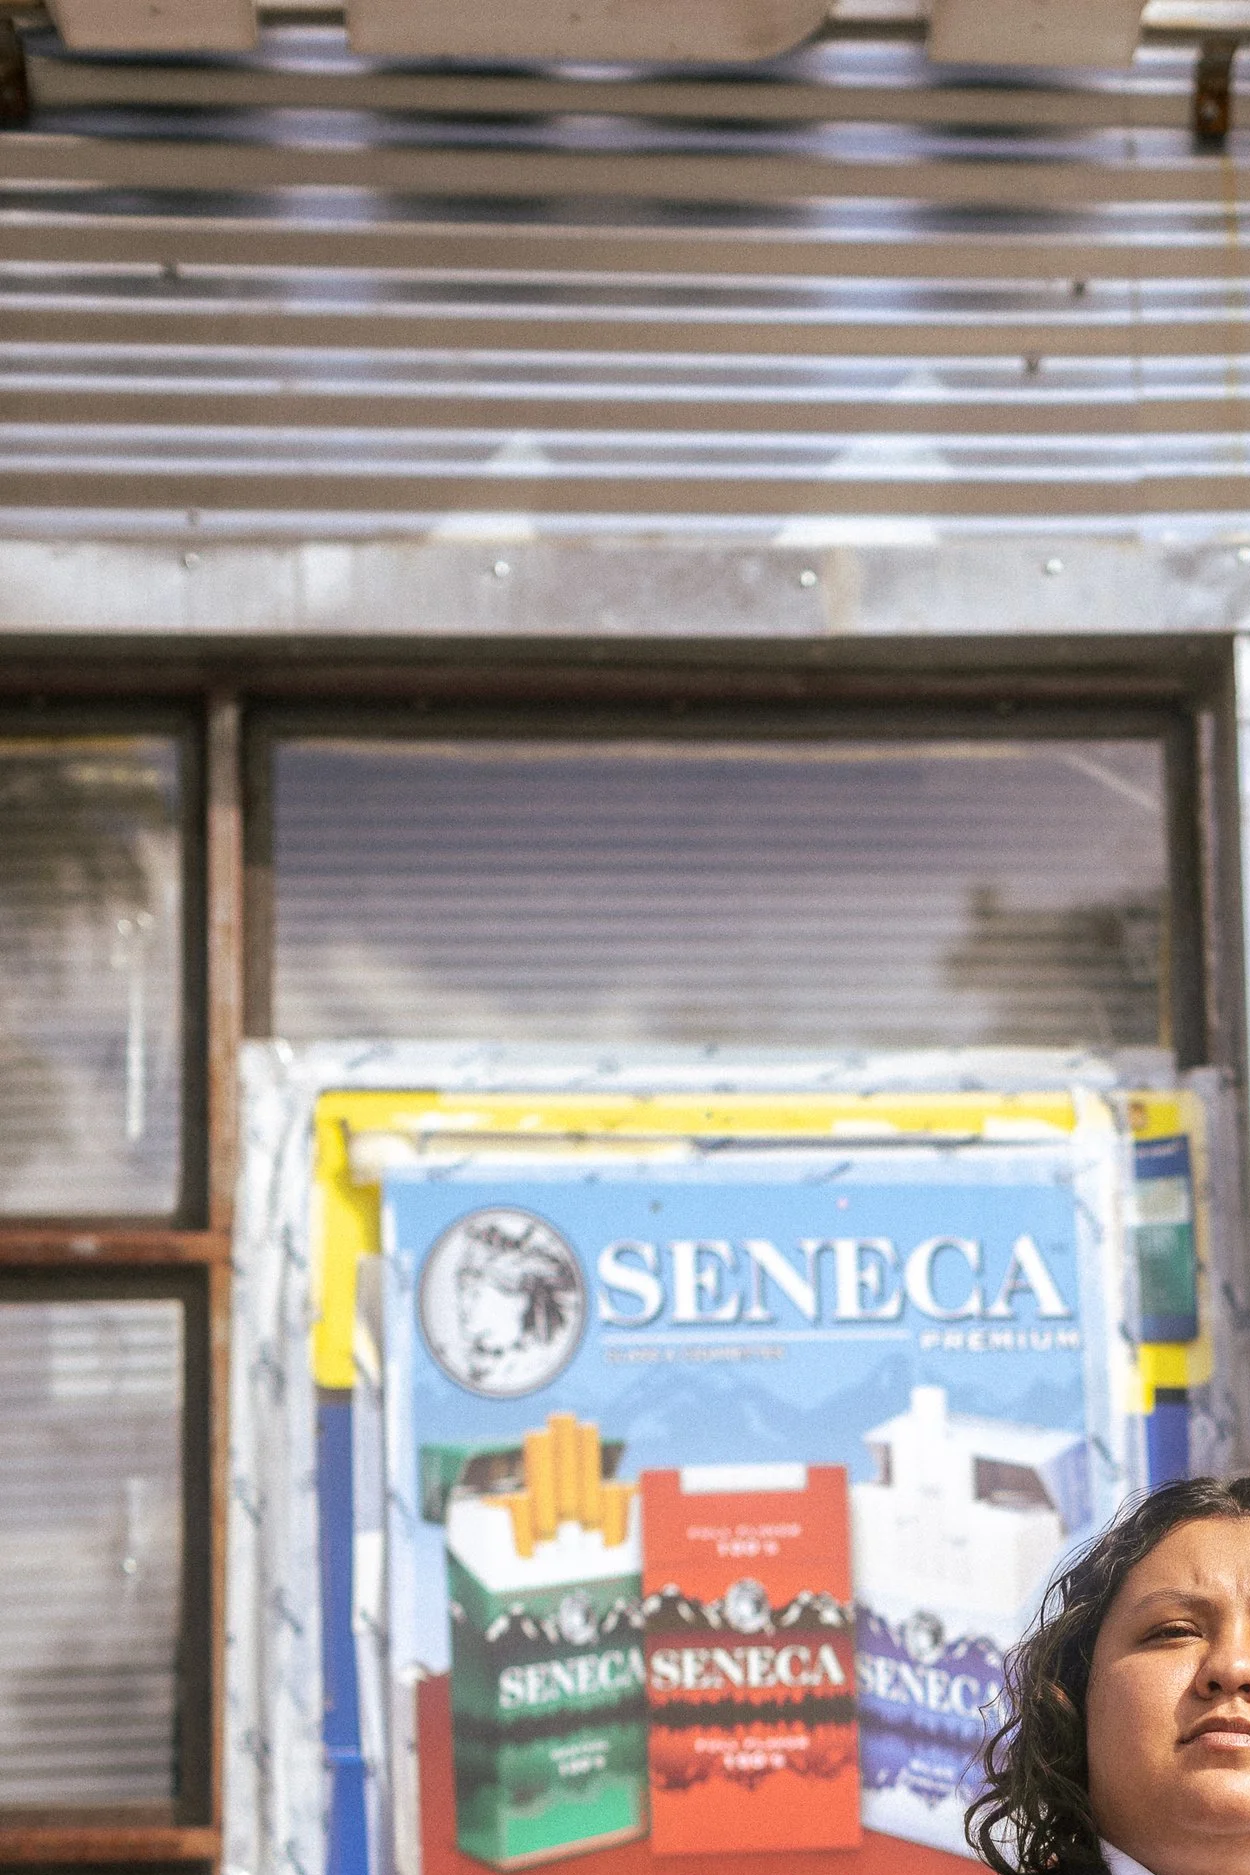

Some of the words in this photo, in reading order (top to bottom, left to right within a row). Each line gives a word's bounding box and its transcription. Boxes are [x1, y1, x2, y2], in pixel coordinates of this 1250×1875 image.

[597, 1235, 1070, 1326] SENECA
[919, 1327, 1081, 1352] PREMIUM
[498, 1646, 647, 1710] SENECA
[649, 1643, 846, 1691] SENECA
